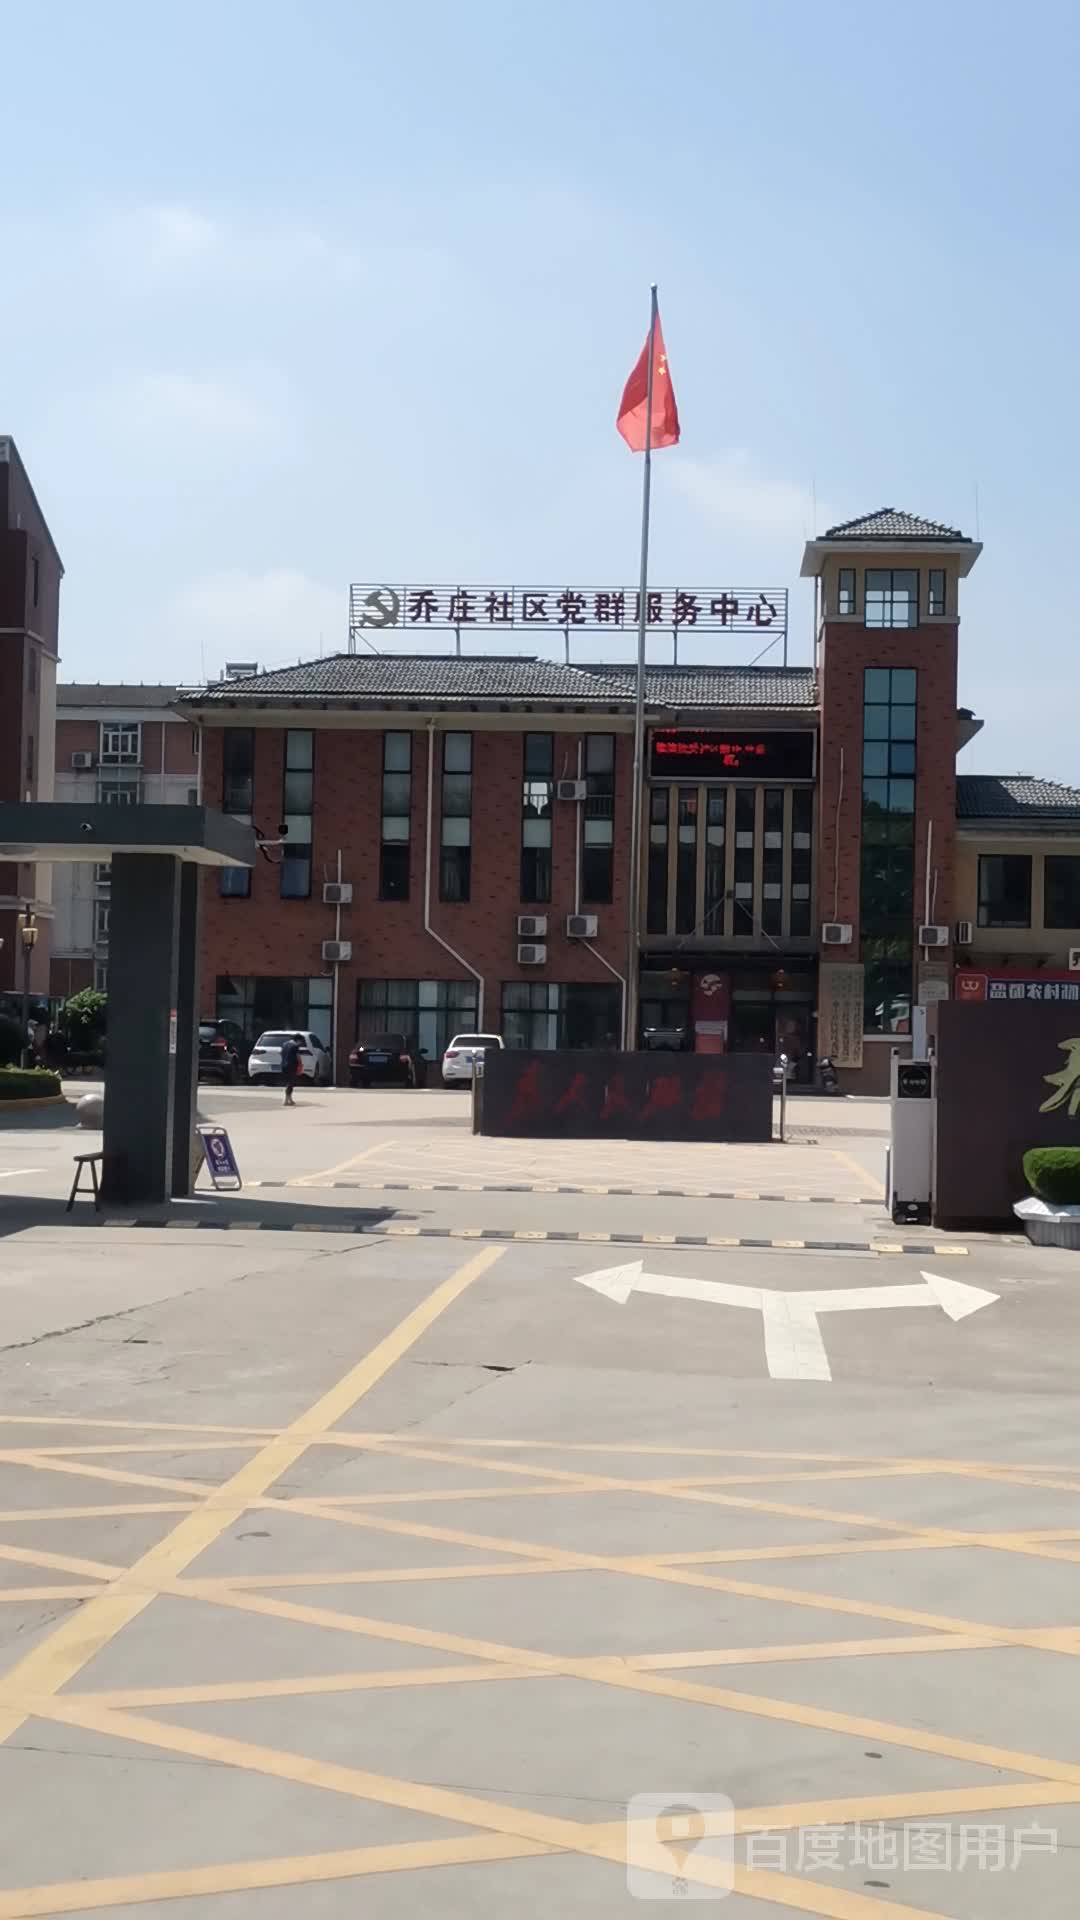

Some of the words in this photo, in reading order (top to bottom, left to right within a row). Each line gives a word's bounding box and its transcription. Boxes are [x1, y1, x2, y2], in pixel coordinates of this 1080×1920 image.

[407, 589, 778, 627] 乔庄社区党群服务中心
